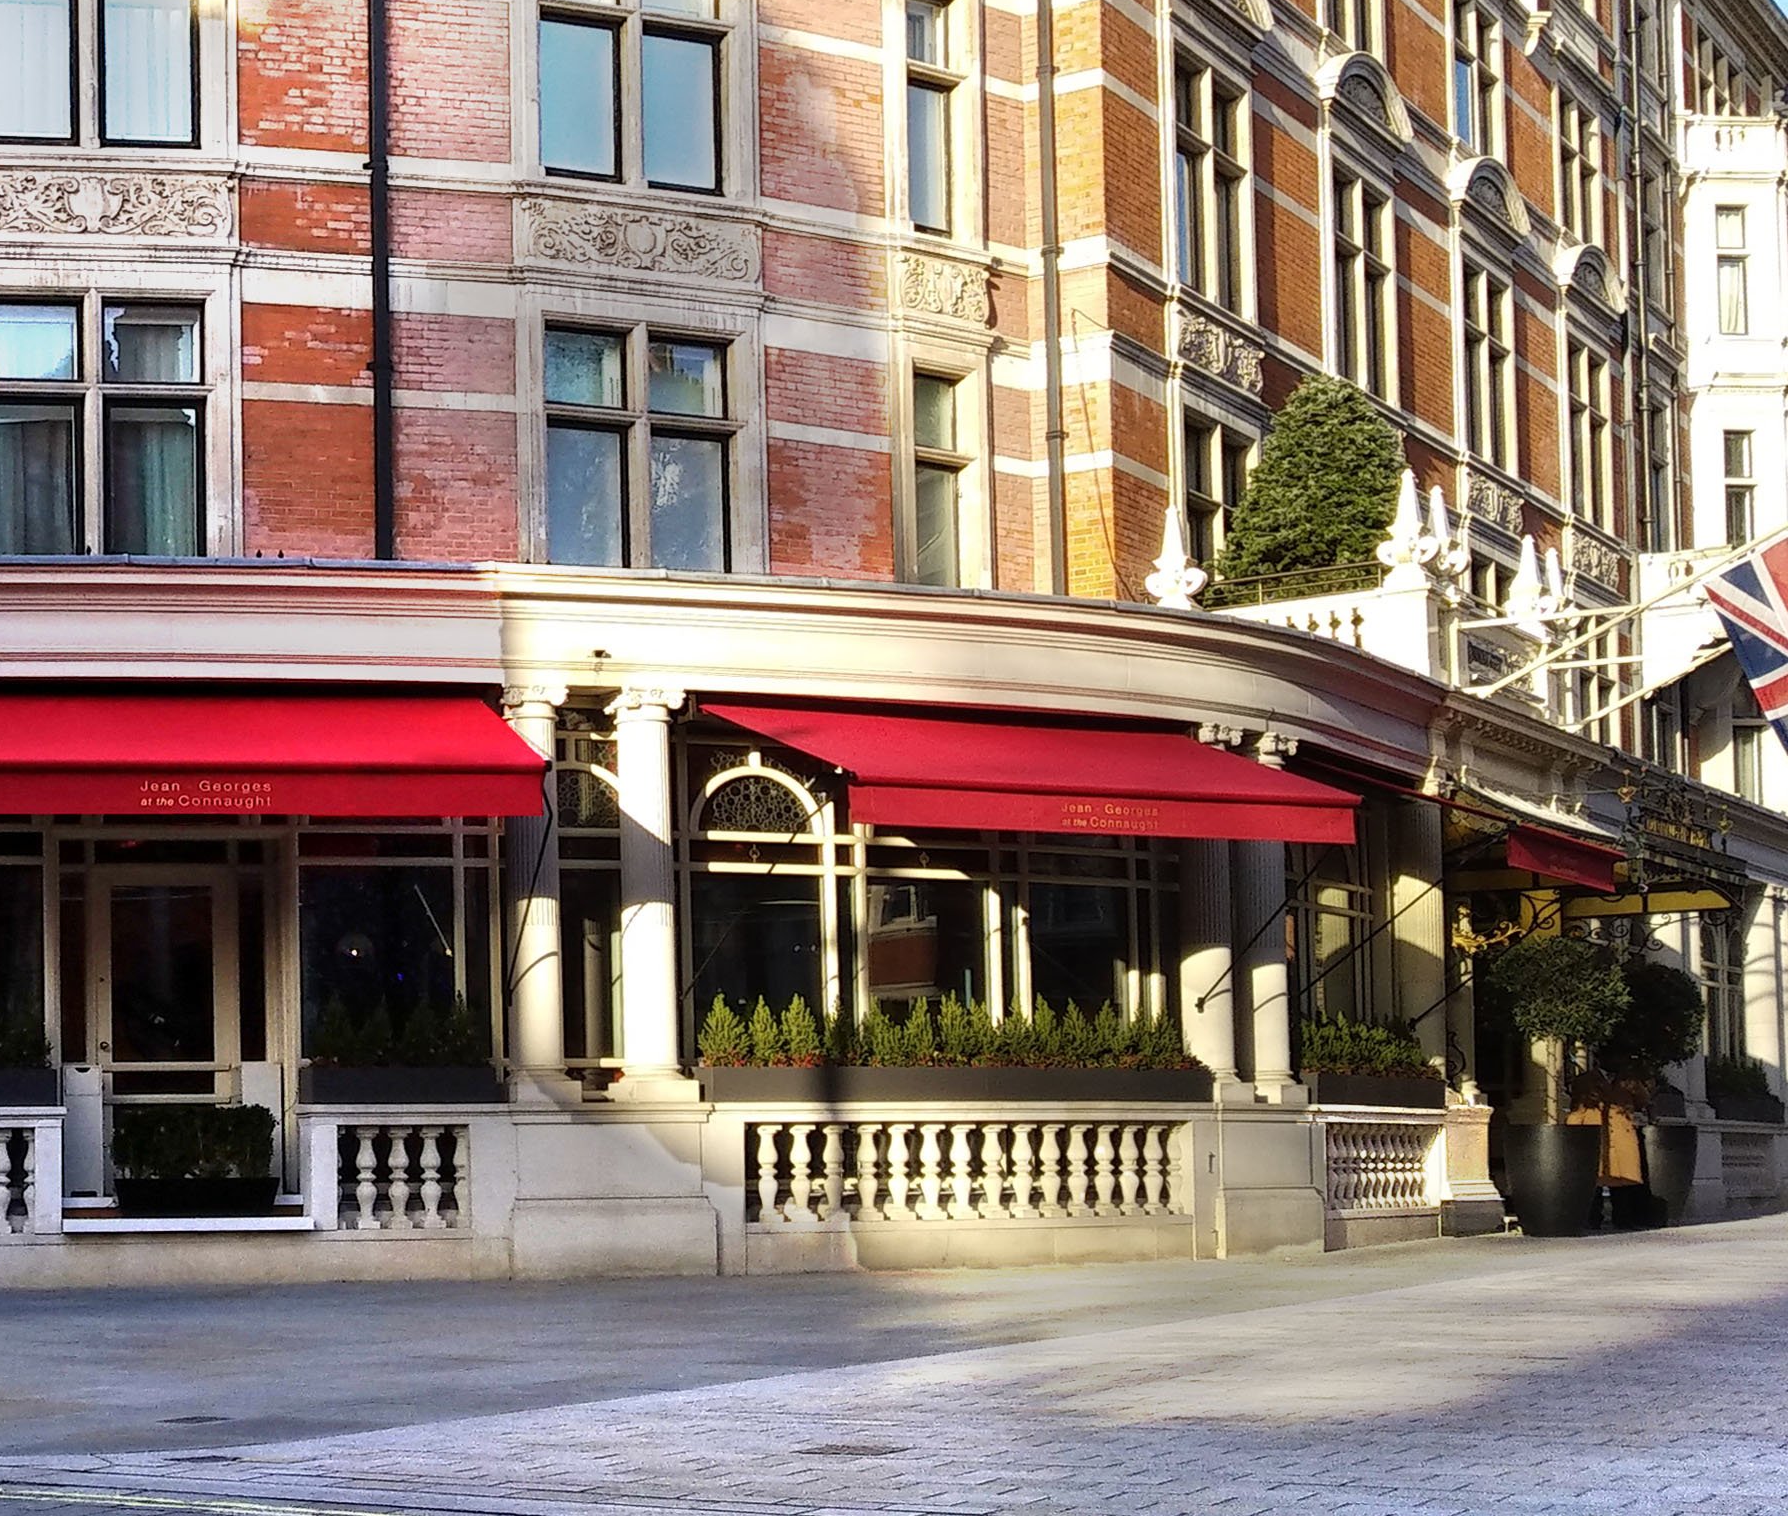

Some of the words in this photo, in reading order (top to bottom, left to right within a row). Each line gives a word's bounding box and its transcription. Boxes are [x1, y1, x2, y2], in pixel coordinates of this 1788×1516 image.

[140, 780, 180, 792] Jean
[199, 780, 272, 794] Georges
[140, 797, 152, 806] at
[156, 797, 174, 807] the
[178, 795, 271, 810] Connaught
[1061, 803, 1092, 813] Jean
[1073, 818, 1087, 827] the
